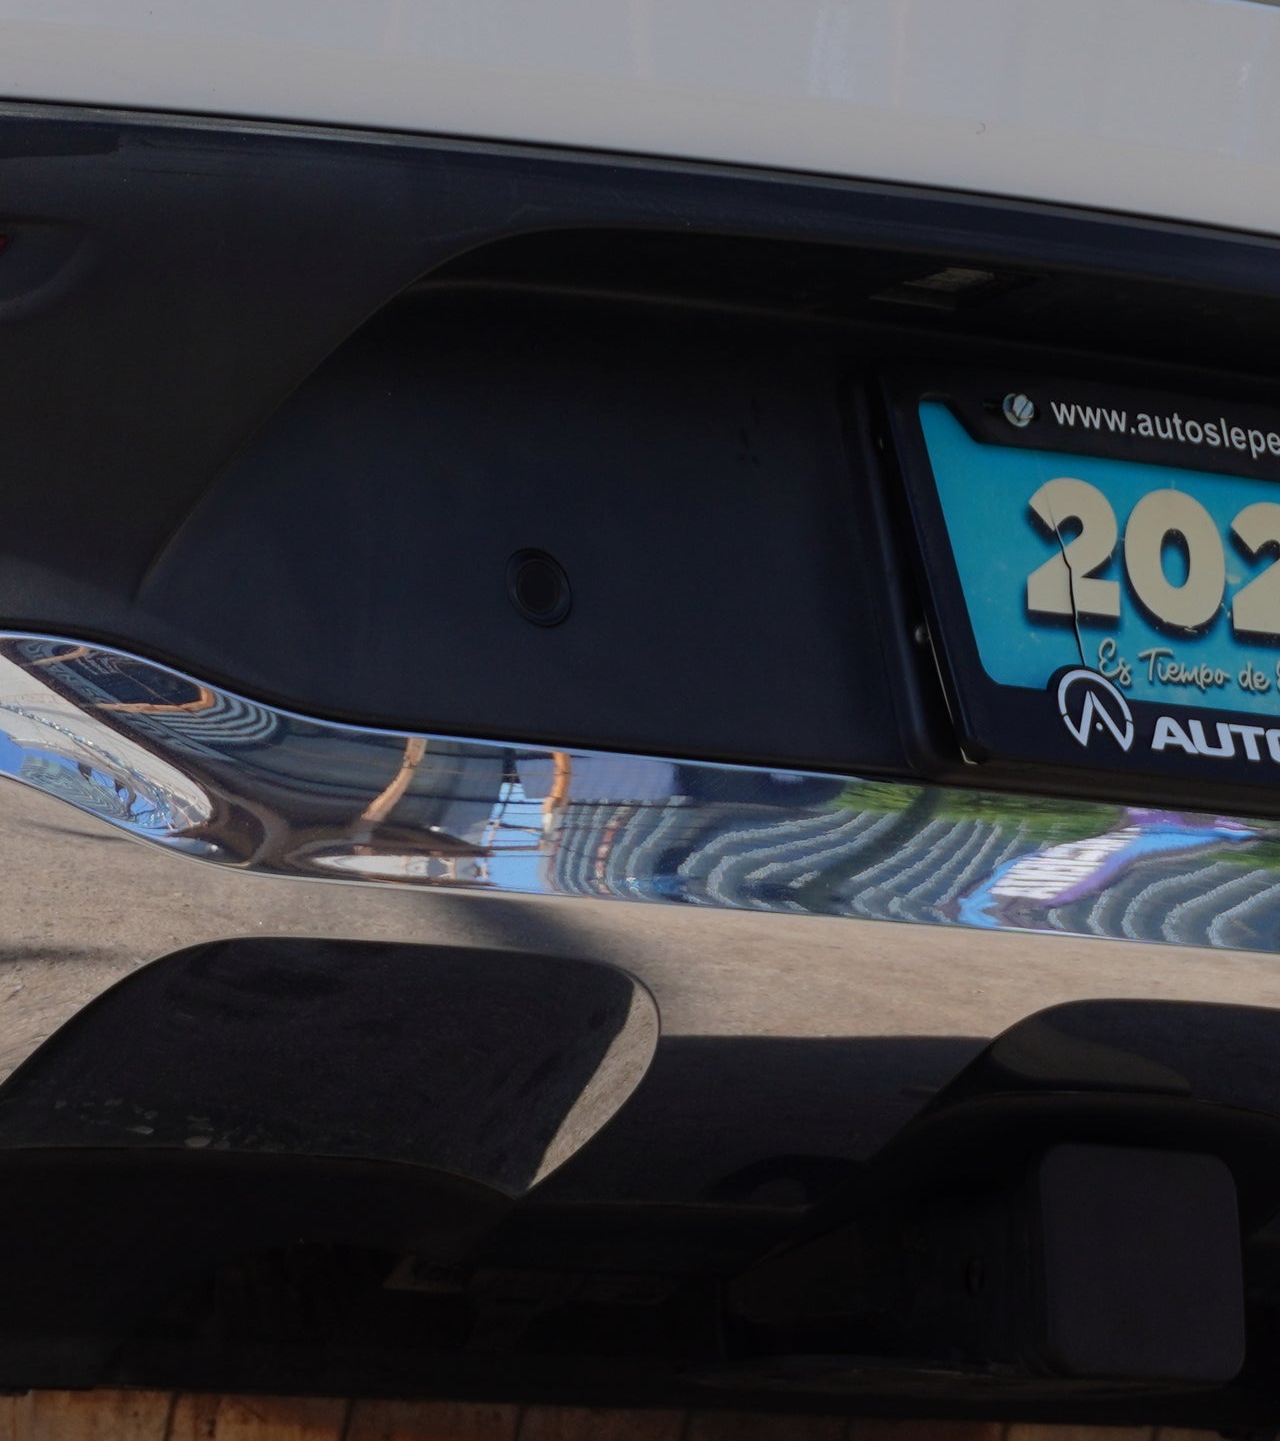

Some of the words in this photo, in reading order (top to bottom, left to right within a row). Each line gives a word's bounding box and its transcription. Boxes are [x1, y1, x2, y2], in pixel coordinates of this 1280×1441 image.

[1098, 637, 1133, 686] Es
[1138, 646, 1231, 691] Tiempo
[1238, 661, 1272, 691] de
